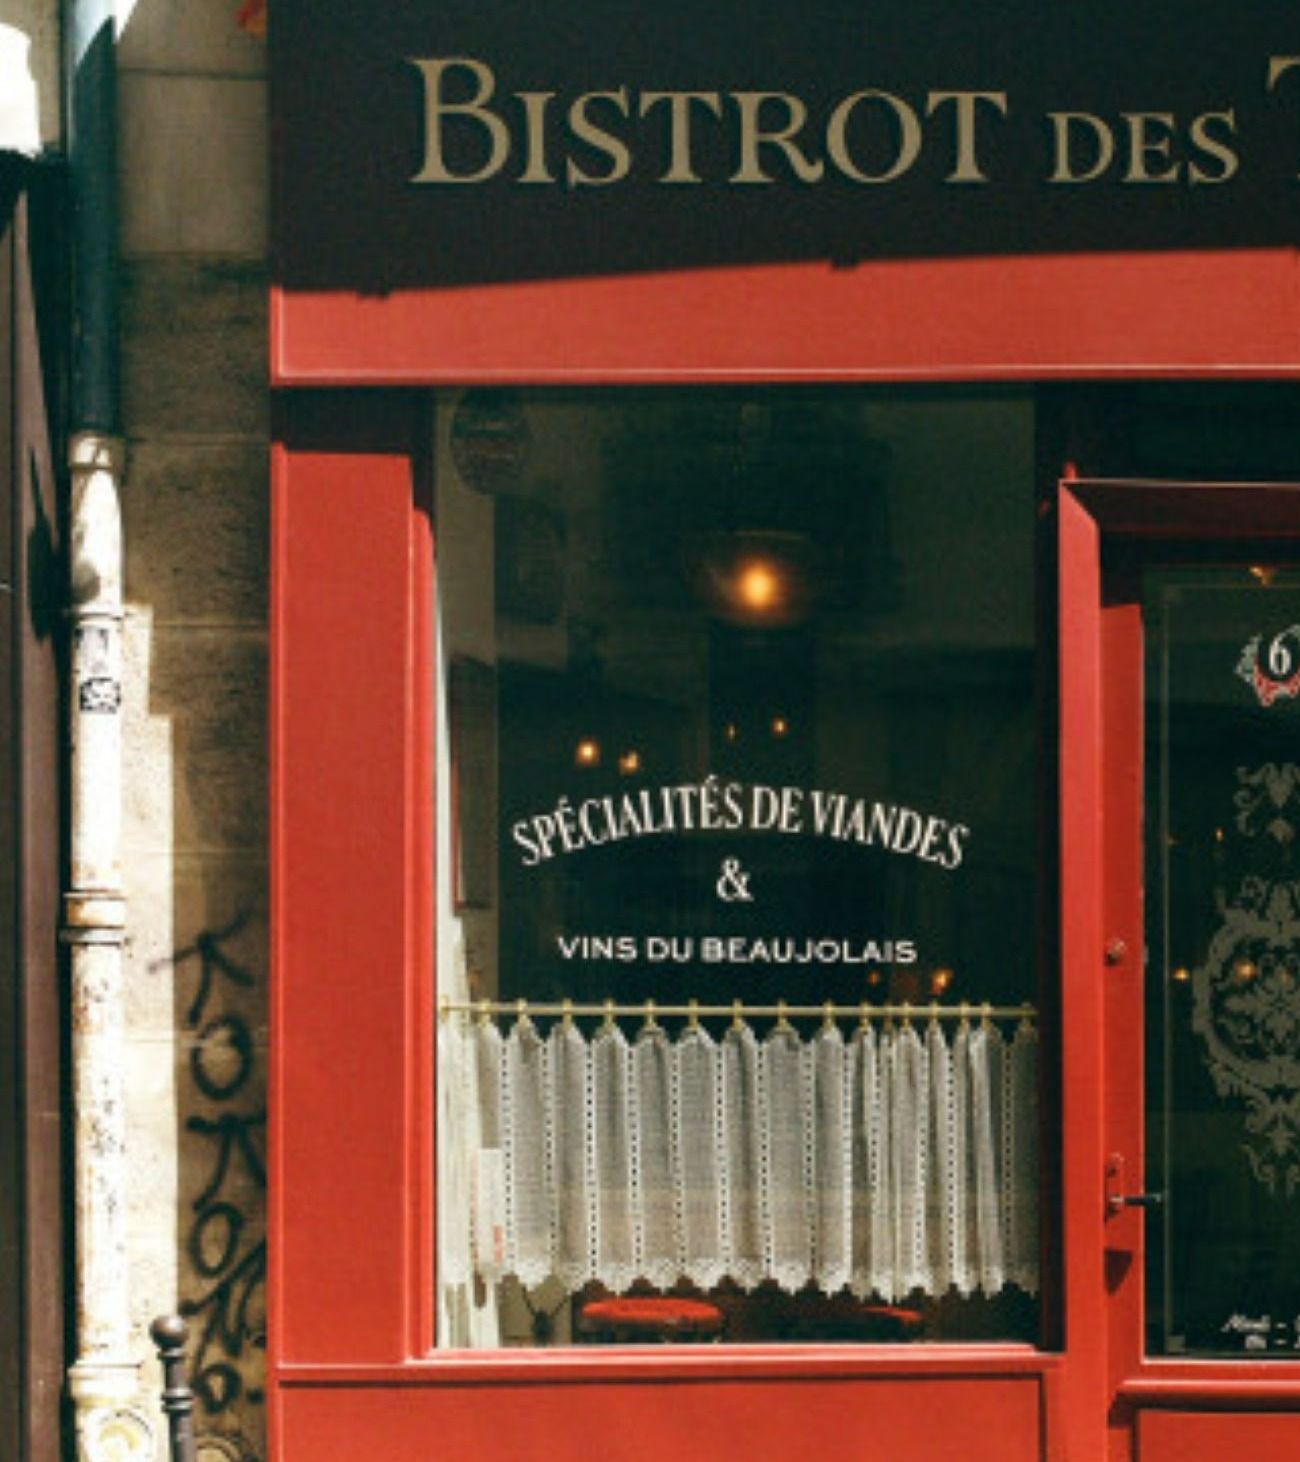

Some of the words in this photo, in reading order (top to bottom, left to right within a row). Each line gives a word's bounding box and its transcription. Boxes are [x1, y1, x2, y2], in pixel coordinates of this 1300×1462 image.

[409, 57, 1008, 187] BISTROT
[1046, 108, 1239, 184] DES
[1268, 630, 1292, 676] 6
[513, 774, 744, 867] SPÉCIALITÉS
[750, 785, 804, 834] DE
[811, 790, 970, 870] VIANDES
[716, 856, 753, 902] &
[557, 936, 638, 961] VINS
[646, 936, 693, 962] DU
[701, 937, 917, 964] BEAUJOLAIS
